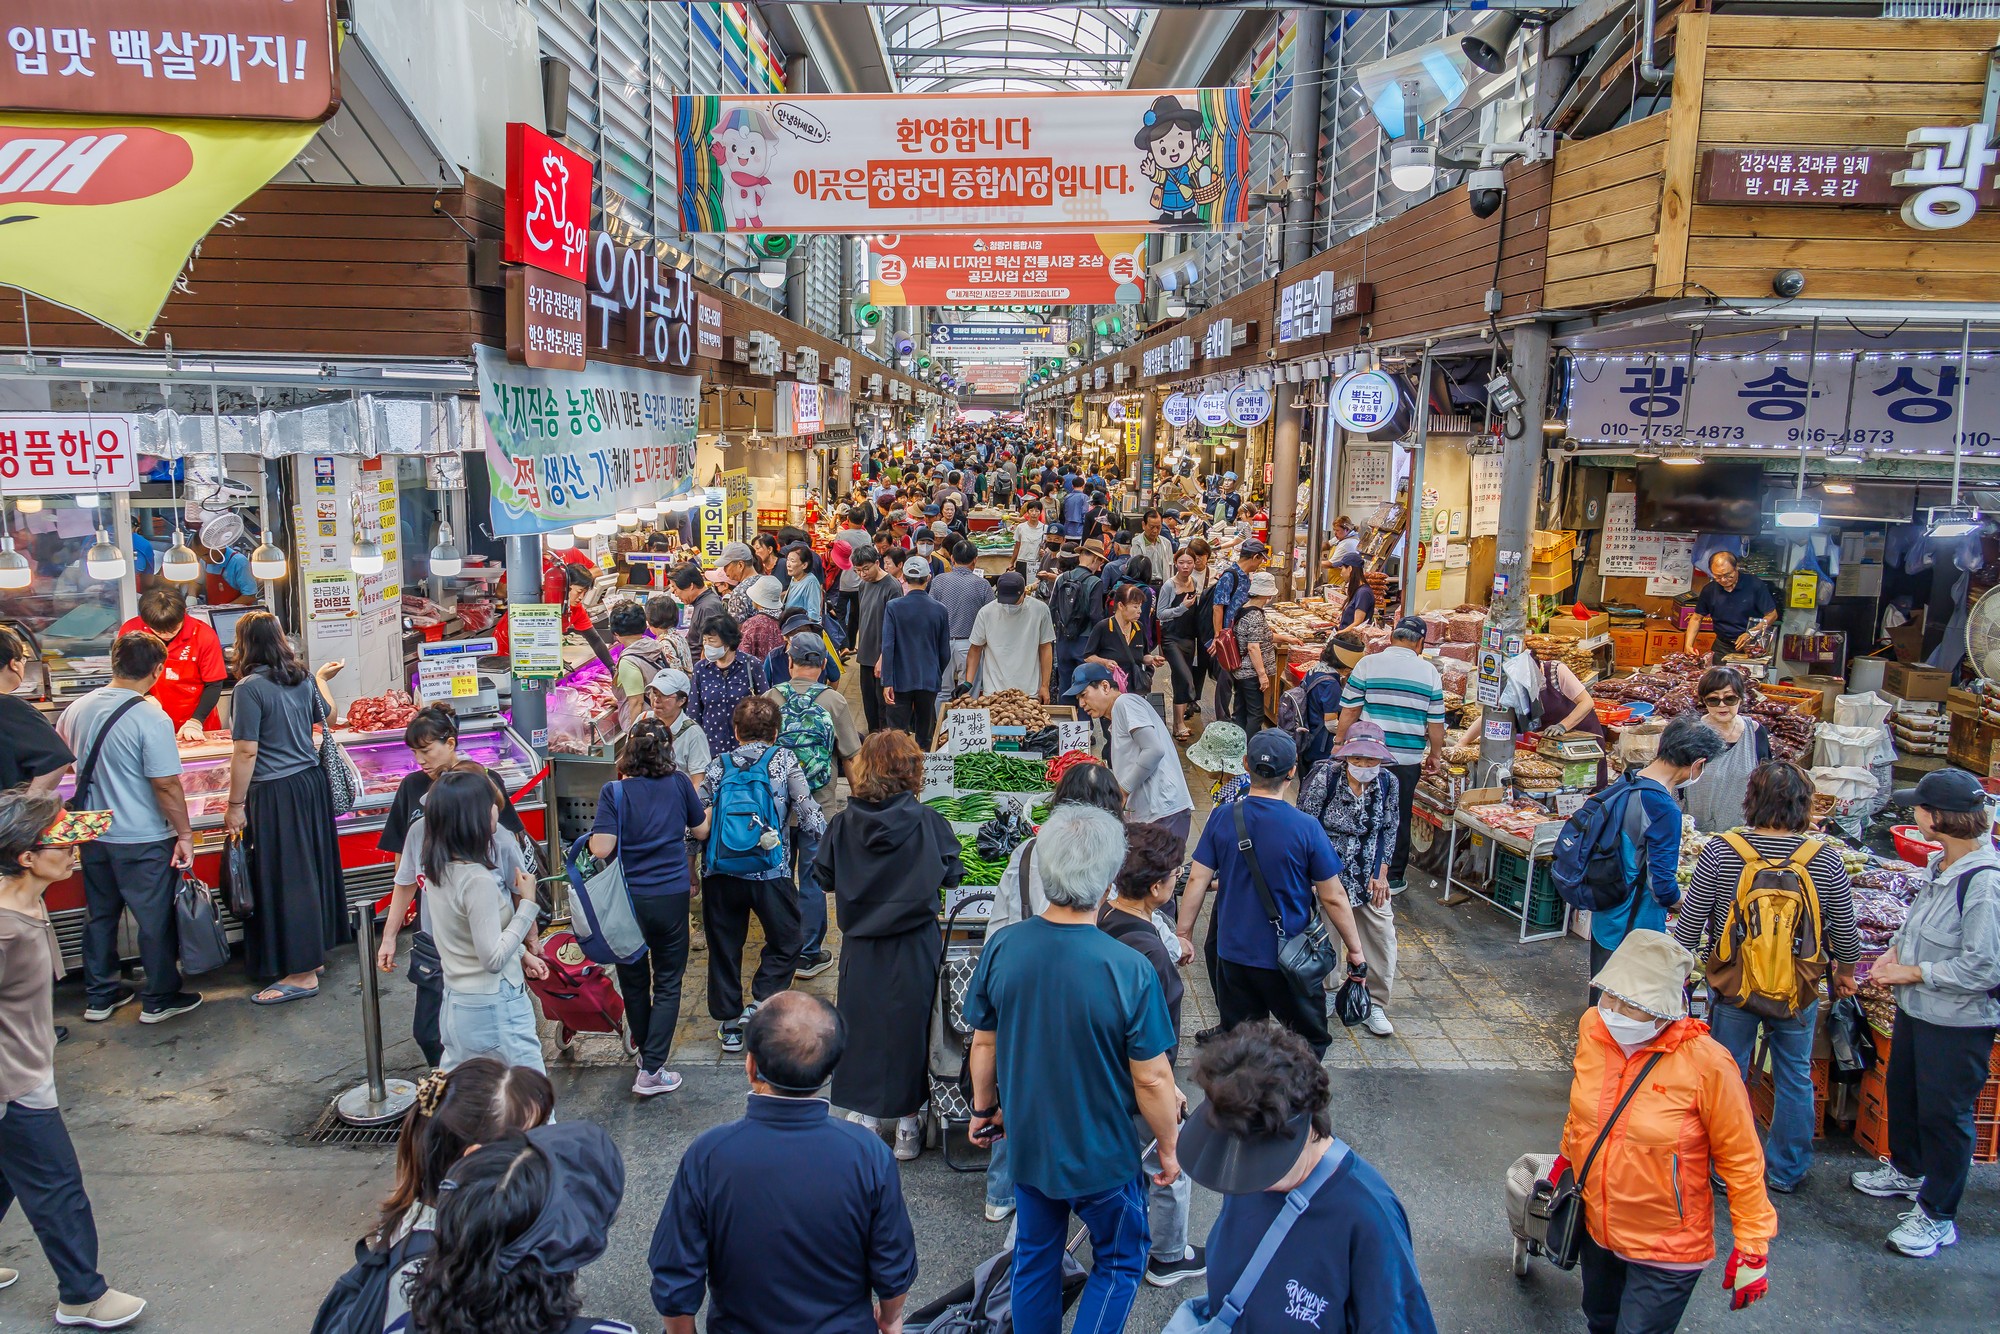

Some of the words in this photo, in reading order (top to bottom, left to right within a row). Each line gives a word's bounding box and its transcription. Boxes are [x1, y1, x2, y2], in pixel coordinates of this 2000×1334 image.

[7, 26, 96, 77] 입맛
[108, 29, 307, 84] 백살까지!
[777, 109, 818, 137] 안녕하세요!
[896, 117, 1031, 153] 환영합니다
[1739, 154, 1838, 174] 건강식품.견과류
[1842, 156, 1870, 175] 일체
[793, 168, 868, 201] 이곳은
[871, 167, 946, 201] 청량리
[949, 165, 1051, 200] 종합시장
[1054, 164, 1135, 197] 입니다.
[562, 221, 587, 272] 우아
[881, 260, 902, 281] 경
[911, 256, 950, 269] 서울시
[953, 255, 992, 269] 디자인
[995, 255, 1021, 269] 혁신
[1024, 255, 1075, 268] 전통시장
[1078, 254, 1104, 268] 조성
[1113, 258, 1134, 279] 축
[968, 271, 1019, 284] 공모사업
[1022, 271, 1048, 283] 선정
[528, 284, 582, 322] 육가공전문업체
[591, 231, 694, 367] 우아농장
[984, 290, 1012, 299] 시장으로
[620, 391, 643, 431] 바로
[644, 392, 667, 432] 우리집
[1600, 422, 1745, 440] 010-7752-4873
[1787, 427, 1895, 445] 966-4873
[312, 585, 350, 598] 환급행사
[313, 596, 351, 609] 참여점포
[1652, 634, 1678, 648] 대추
